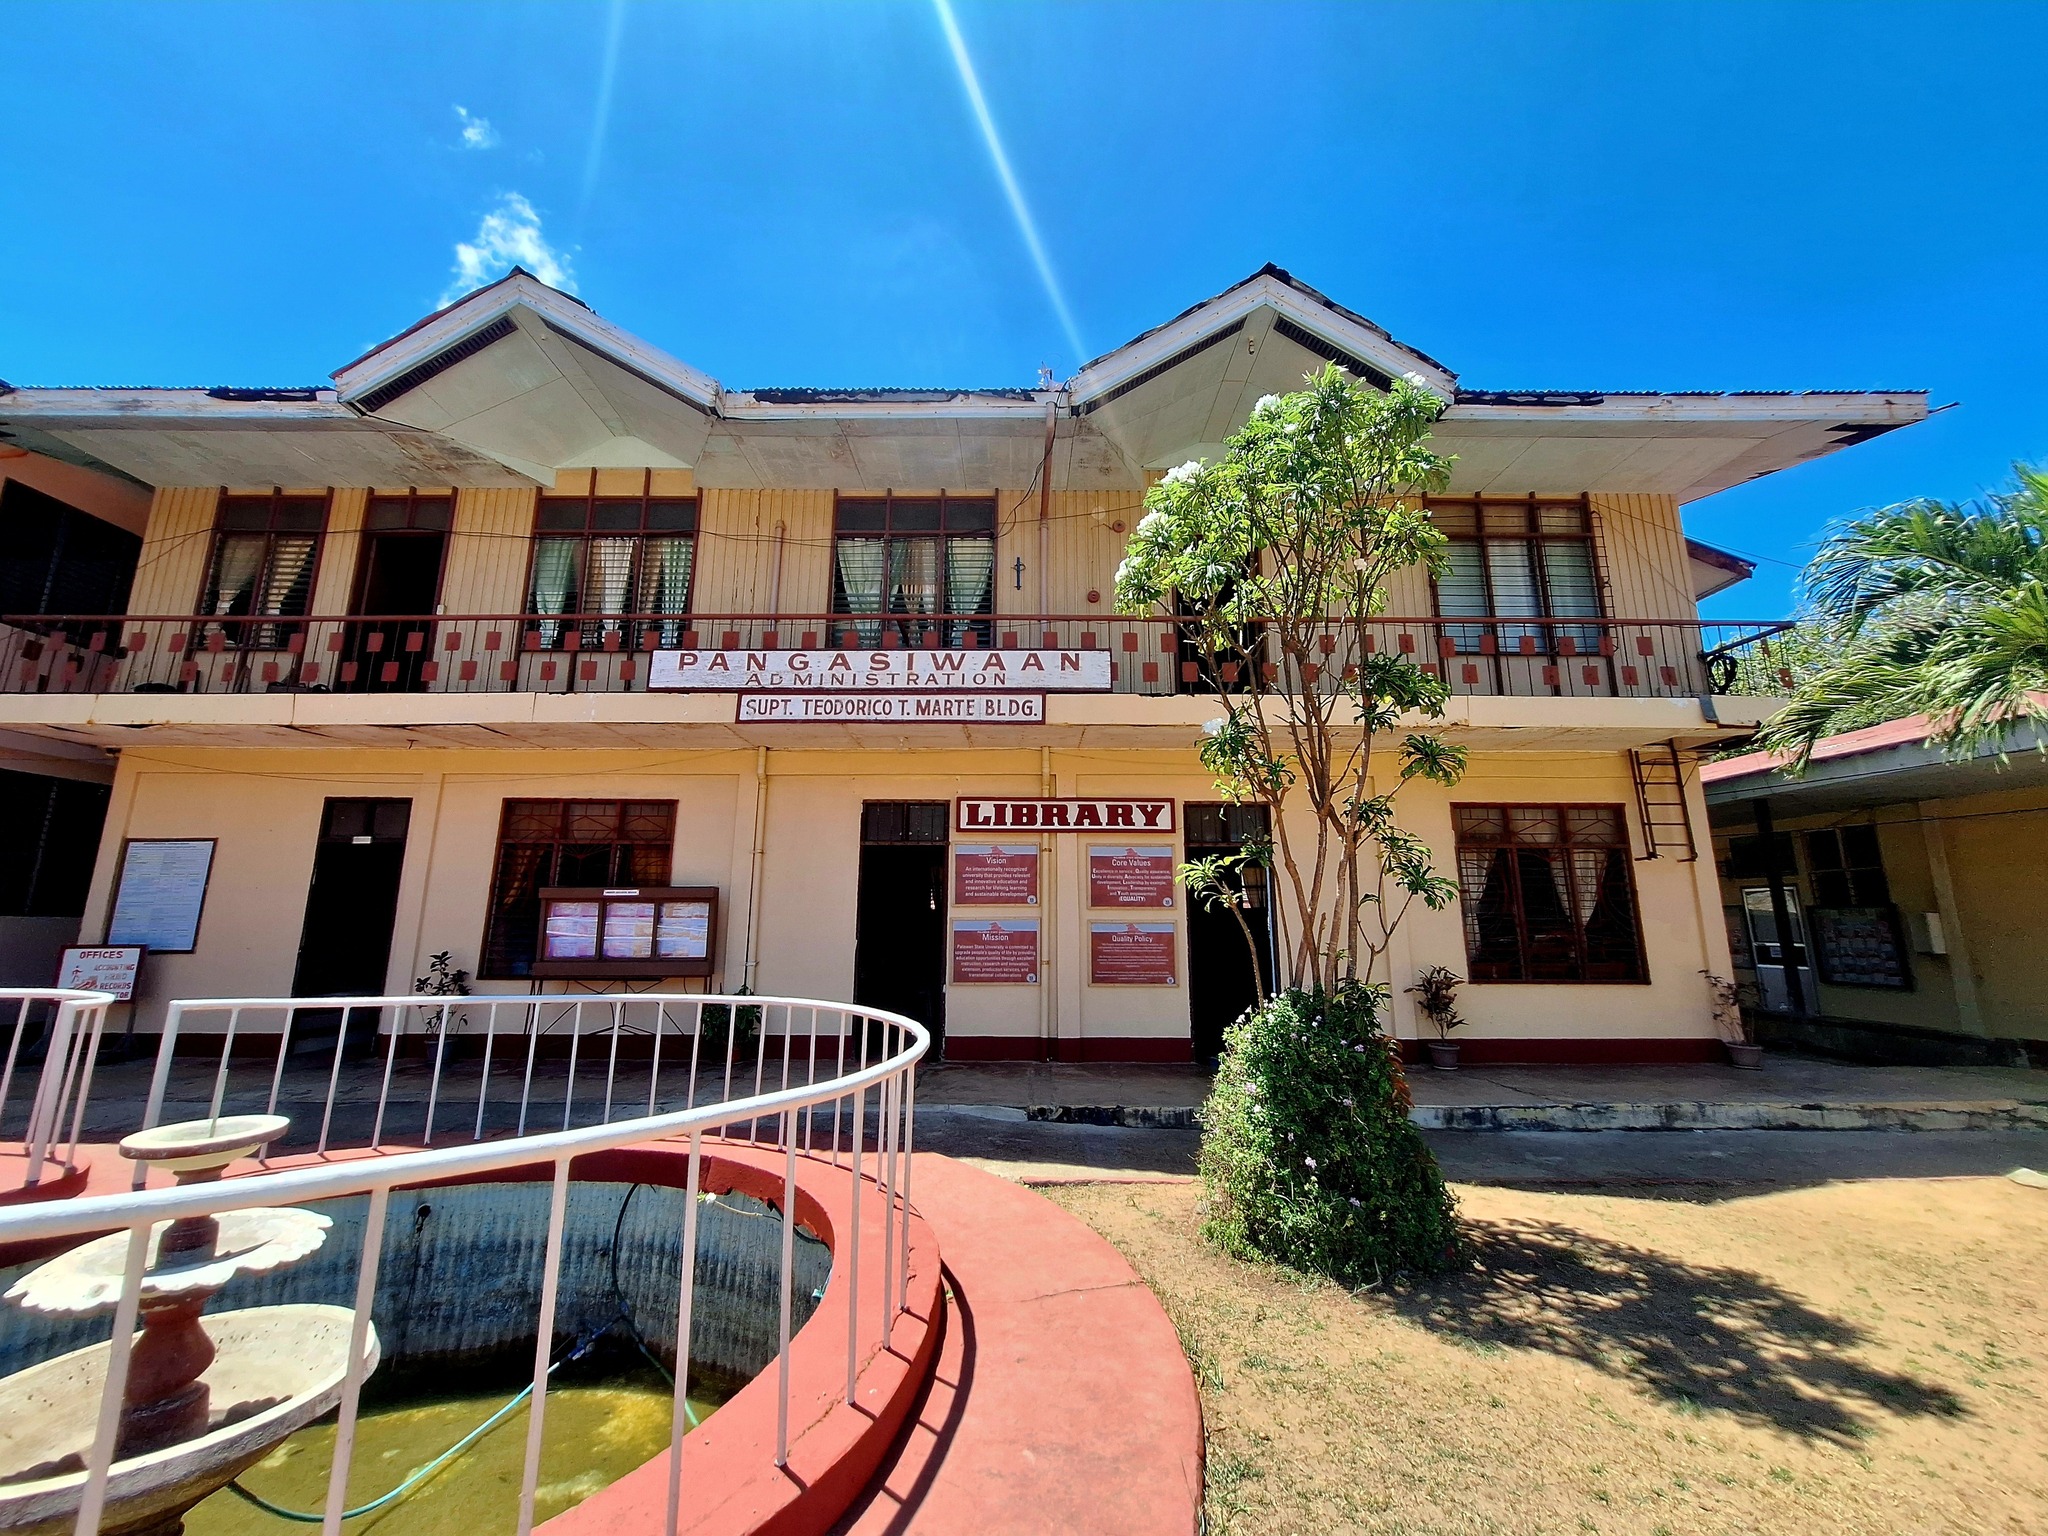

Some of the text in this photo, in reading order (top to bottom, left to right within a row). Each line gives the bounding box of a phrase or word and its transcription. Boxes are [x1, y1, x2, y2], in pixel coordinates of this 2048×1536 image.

[678, 652, 1080, 671] PANGASIWAAN
[745, 673, 1006, 686] ADMINISTRATION
[746, 699, 1038, 717] SUPT. TEODORICO T. MARTE BLDG.
[966, 803, 1165, 827] LIBRARY
[80, 951, 123, 959] OFFICES
